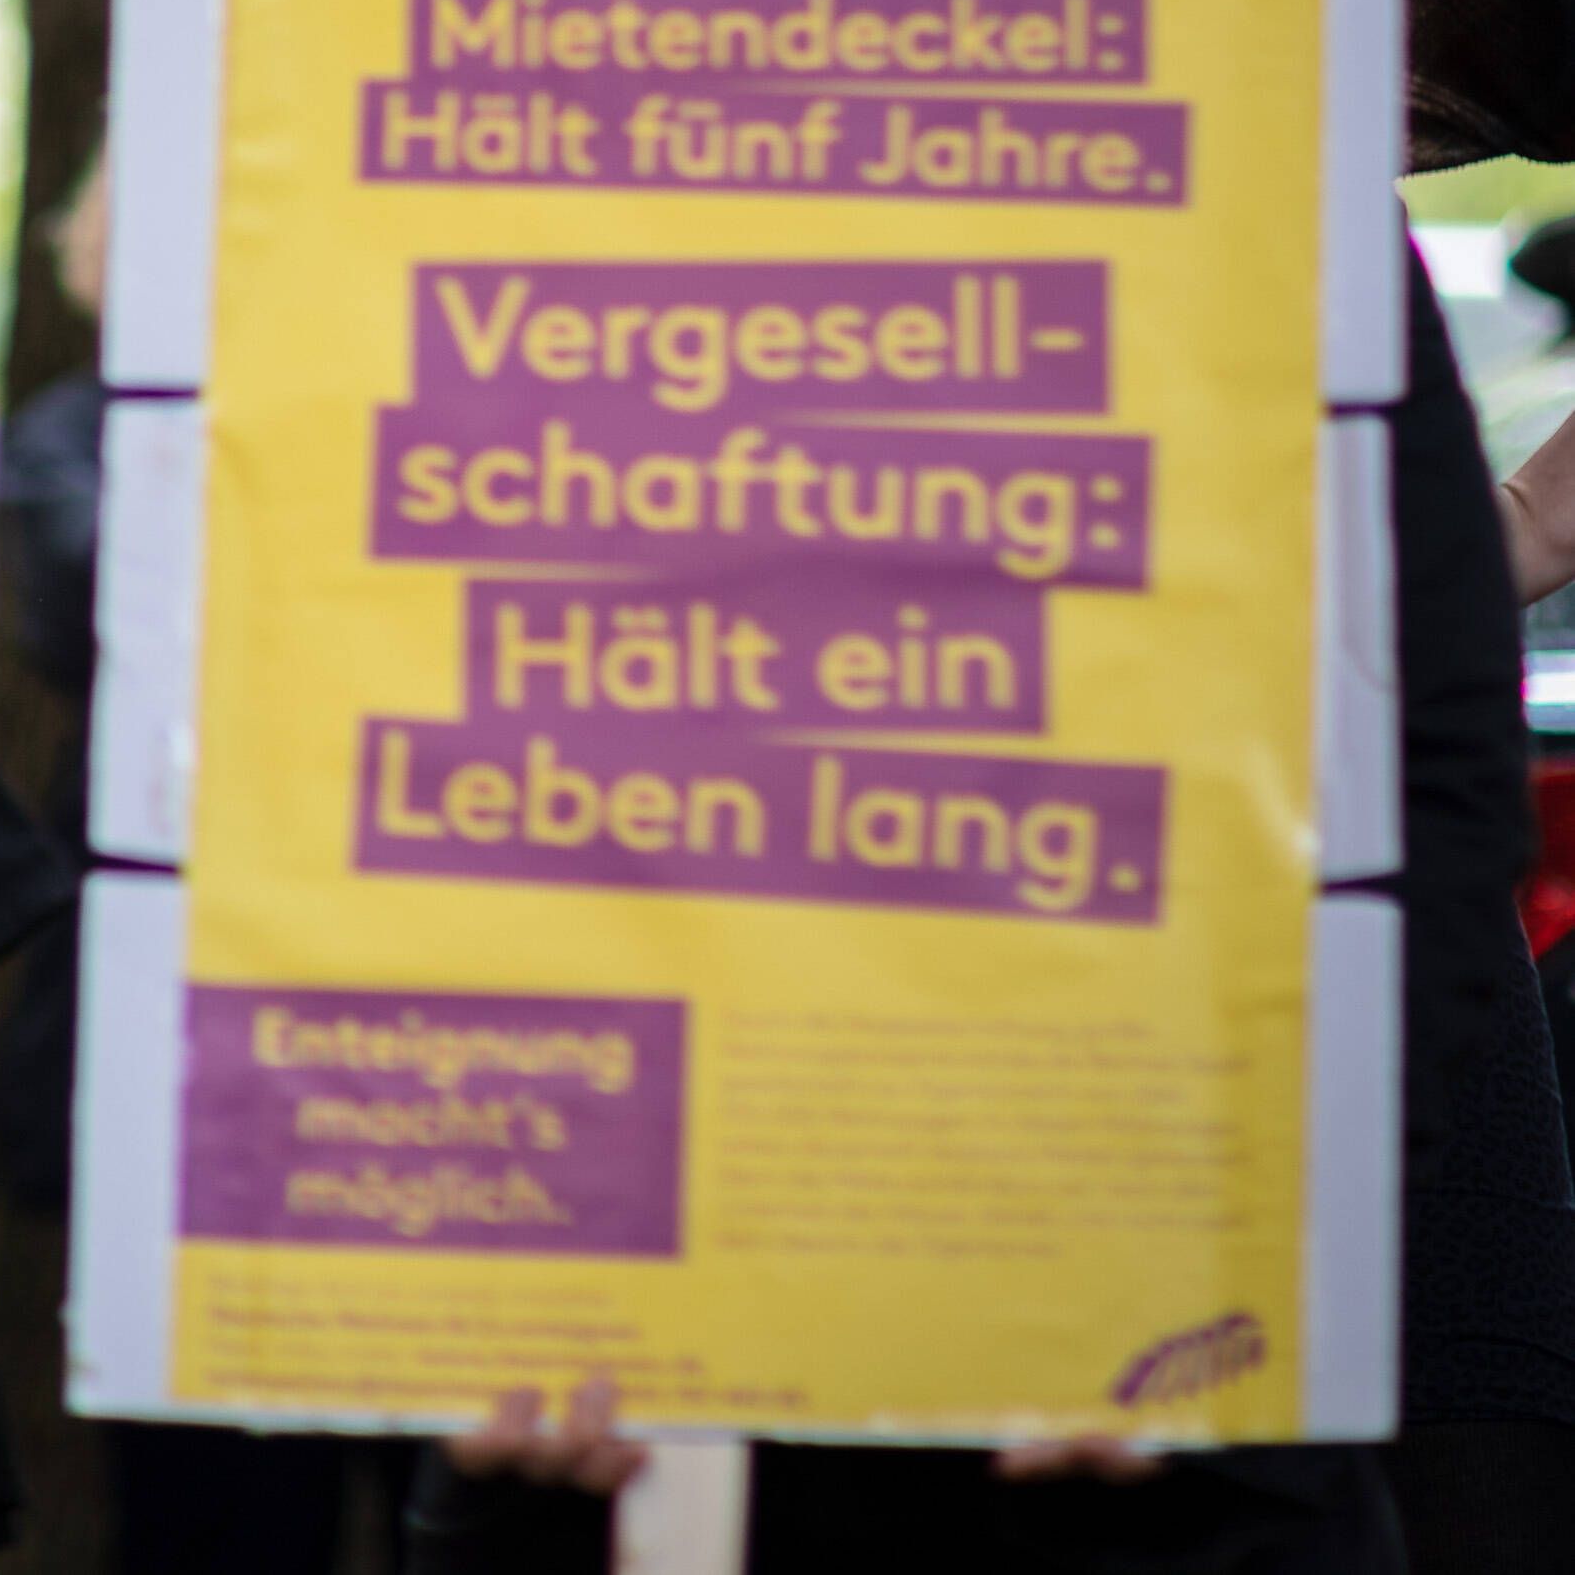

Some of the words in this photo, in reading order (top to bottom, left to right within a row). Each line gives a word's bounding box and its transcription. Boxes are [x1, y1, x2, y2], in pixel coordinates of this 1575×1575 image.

[379, 92, 599, 176] Hält
[629, 96, 844, 184] fünf
[858, 105, 1174, 195] Jahre.
[434, 274, 1085, 412] Vergesell-
[394, 422, 1126, 580] schaftung:
[493, 603, 779, 711] Hält
[816, 607, 1016, 711] ein
[374, 727, 768, 859] Leben
[808, 754, 1142, 913] lang.
[254, 1006, 635, 1095] Enteignung
